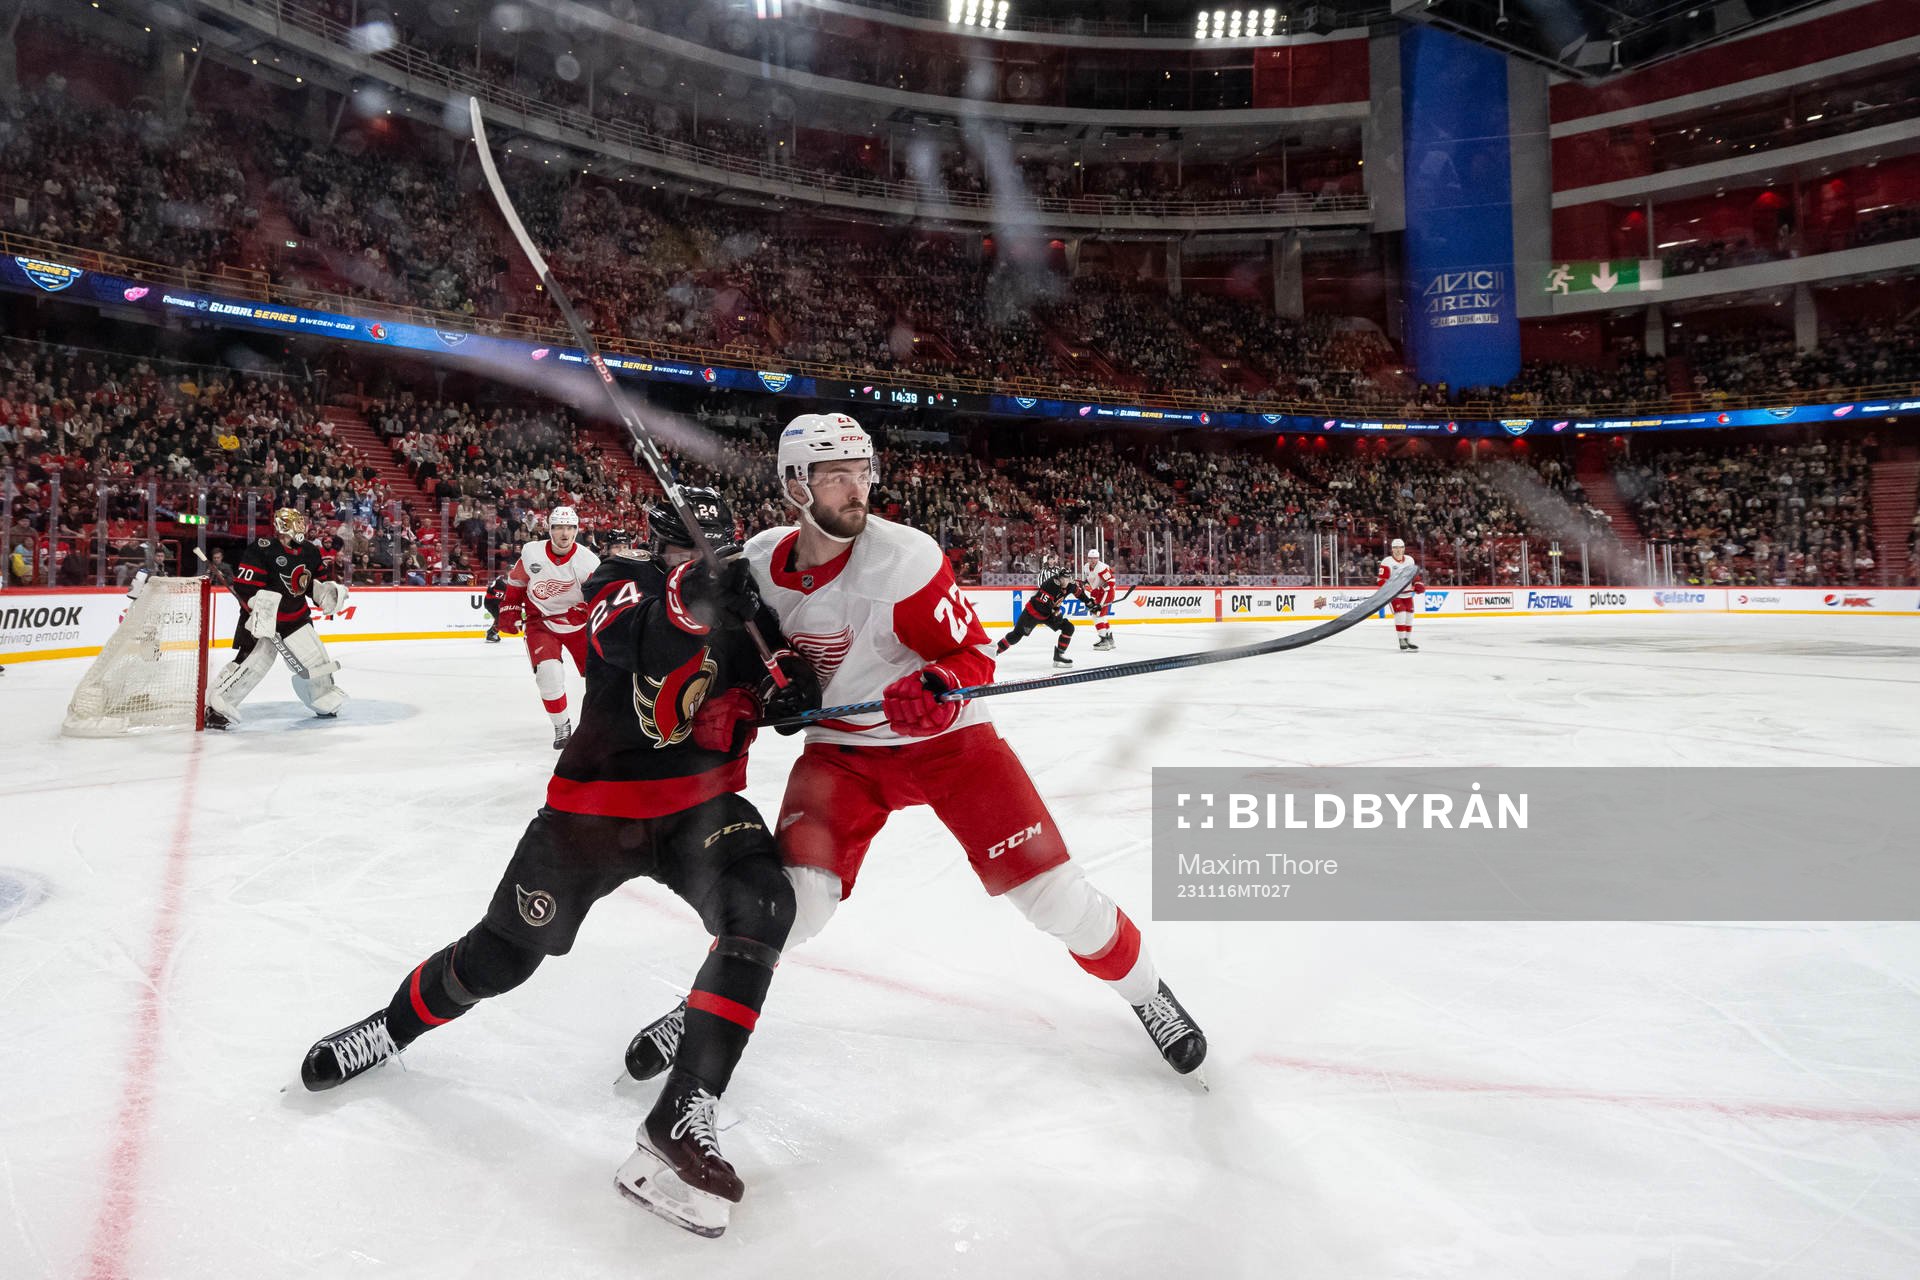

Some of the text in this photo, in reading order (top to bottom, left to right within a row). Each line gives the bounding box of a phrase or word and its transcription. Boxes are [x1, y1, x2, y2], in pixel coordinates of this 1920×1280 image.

[209, 301, 252, 317] GLOBAL
[253, 309, 297, 323] SERIES
[622, 361, 653, 372] SERIES
[891, 391, 918, 404] 14:39
[698, 503, 719, 518] 24
[238, 567, 254, 582] 70
[590, 580, 644, 634] 24
[1231, 594, 1252, 612] CAT
[1276, 594, 1296, 612] CAT
[1424, 594, 1444, 608] SAP
[1467, 596, 1511, 606] LIVE NATION
[1527, 591, 1573, 608] FASTENAL
[1653, 591, 1705, 607] Telstra
[35, 631, 80, 642] emotion
[703, 821, 762, 849] CCM
[987, 822, 1042, 860] CCM
